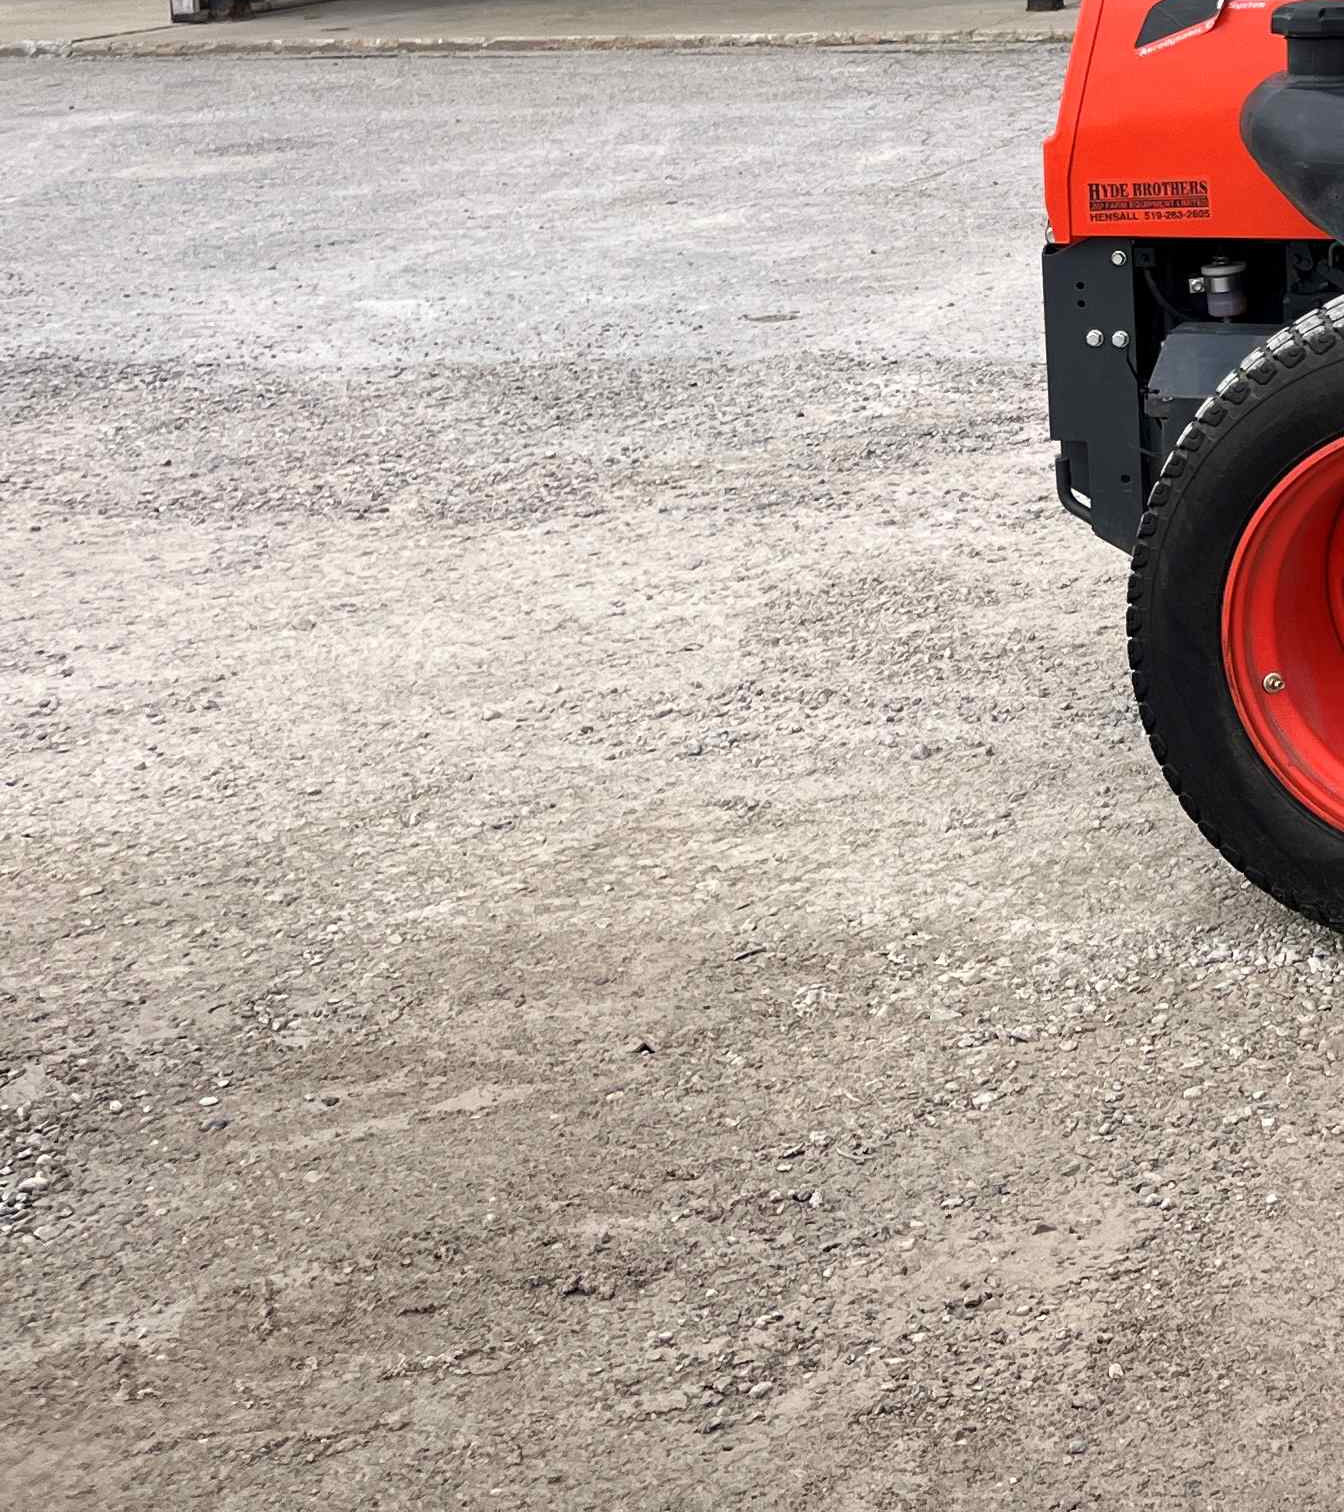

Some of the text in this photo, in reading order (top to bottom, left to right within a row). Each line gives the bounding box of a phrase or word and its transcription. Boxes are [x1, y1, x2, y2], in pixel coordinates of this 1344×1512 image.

[1088, 180, 1208, 200] HYDE BROTHERS
[1090, 211, 1138, 221] HENSALL
